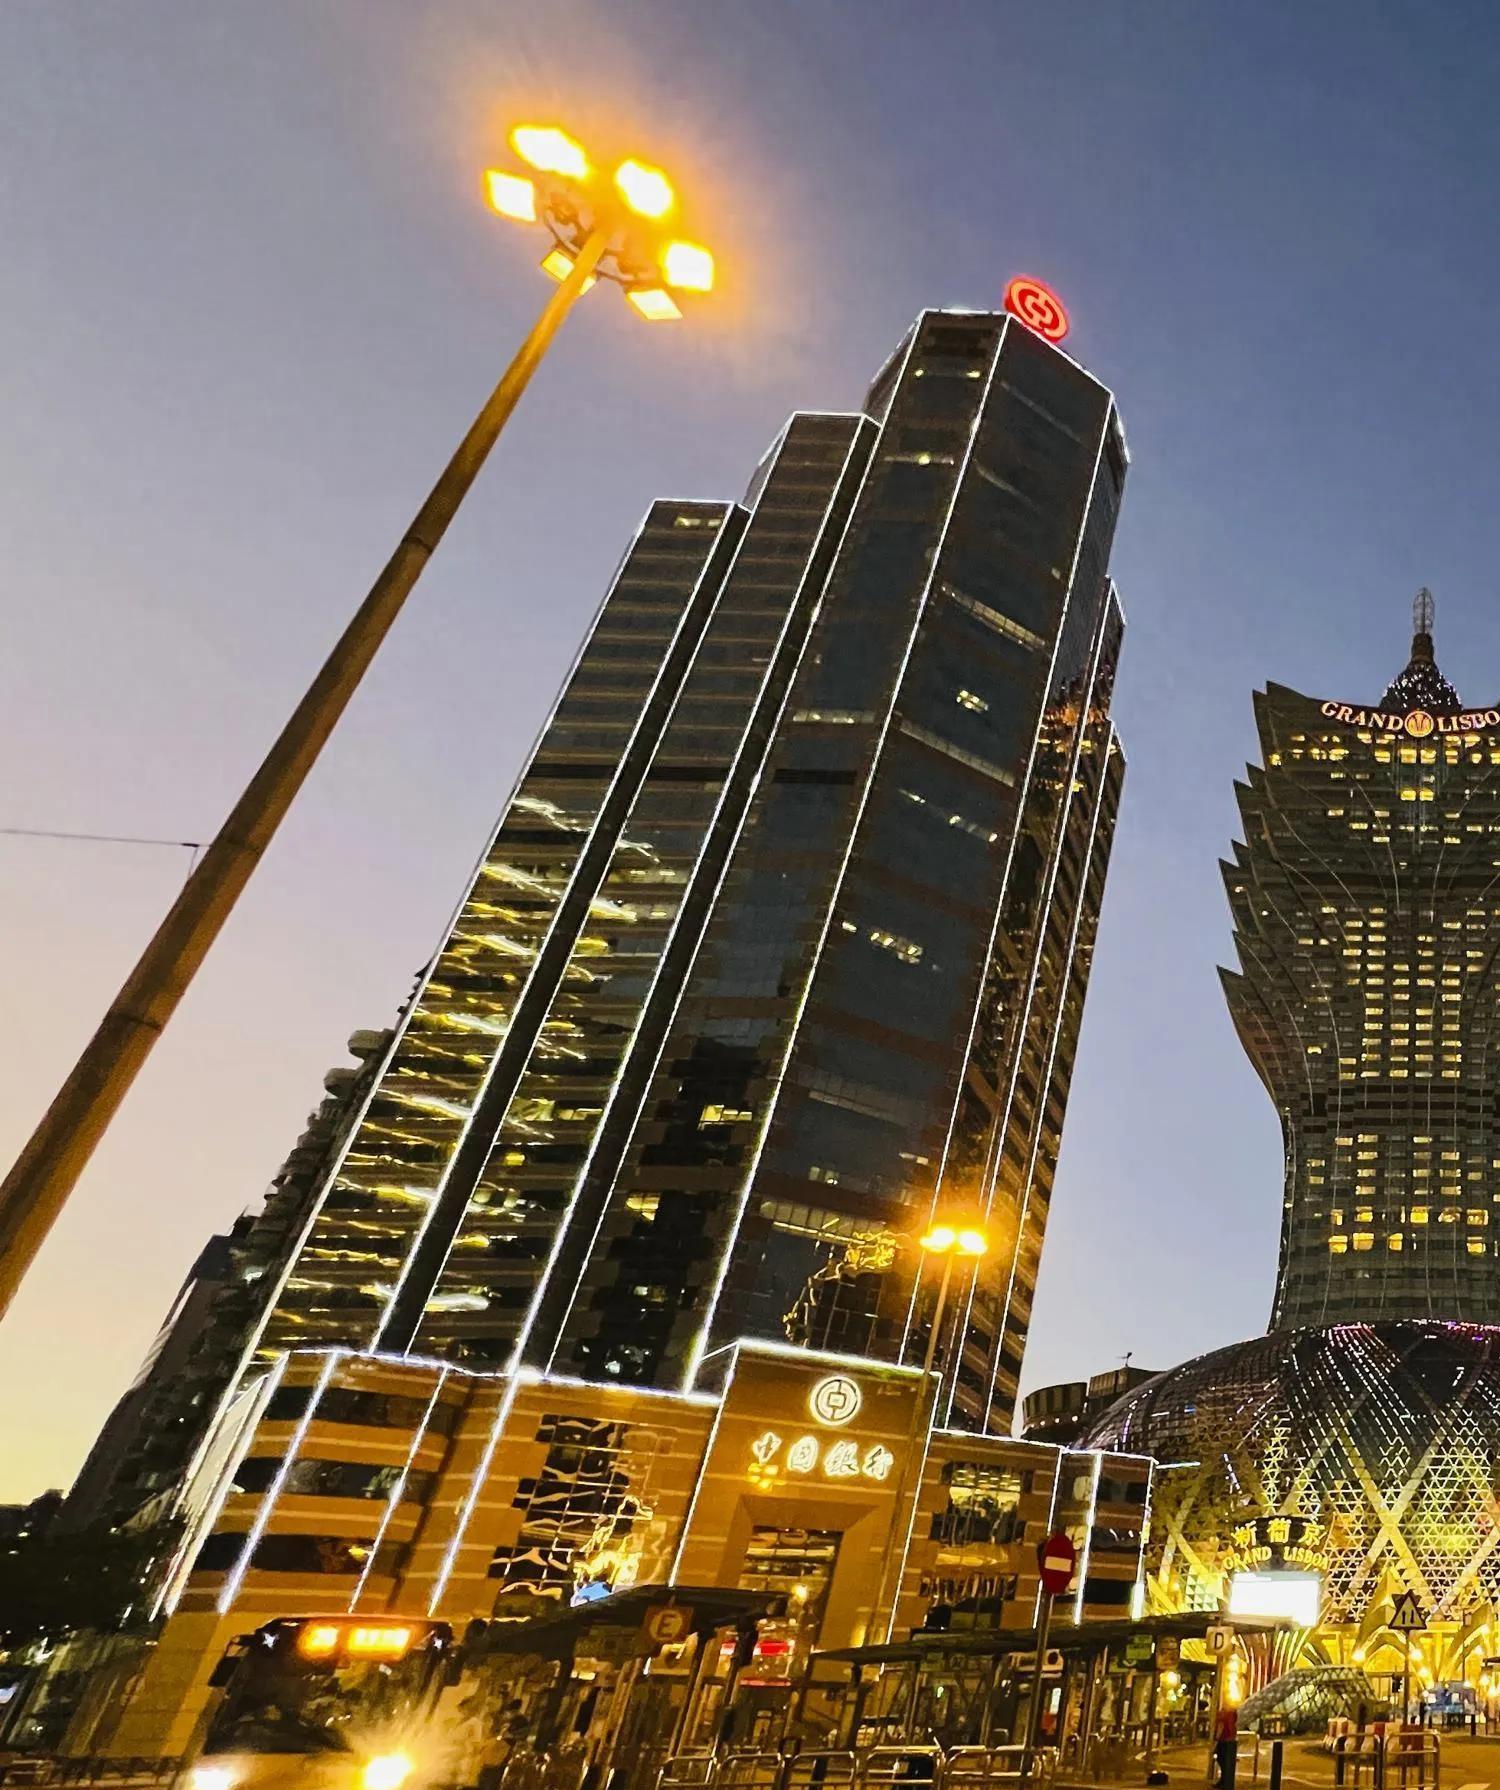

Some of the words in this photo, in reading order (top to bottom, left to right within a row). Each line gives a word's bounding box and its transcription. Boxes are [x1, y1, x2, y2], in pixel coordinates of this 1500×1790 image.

[1321, 702, 1404, 731] GRAND
[1230, 1517, 1329, 1550] 新葡京
[1223, 1546, 1273, 1570] GRAND
[1282, 1546, 1329, 1570] LISBOA
[656, 1613, 679, 1639] E
[1214, 1631, 1225, 1650] D
